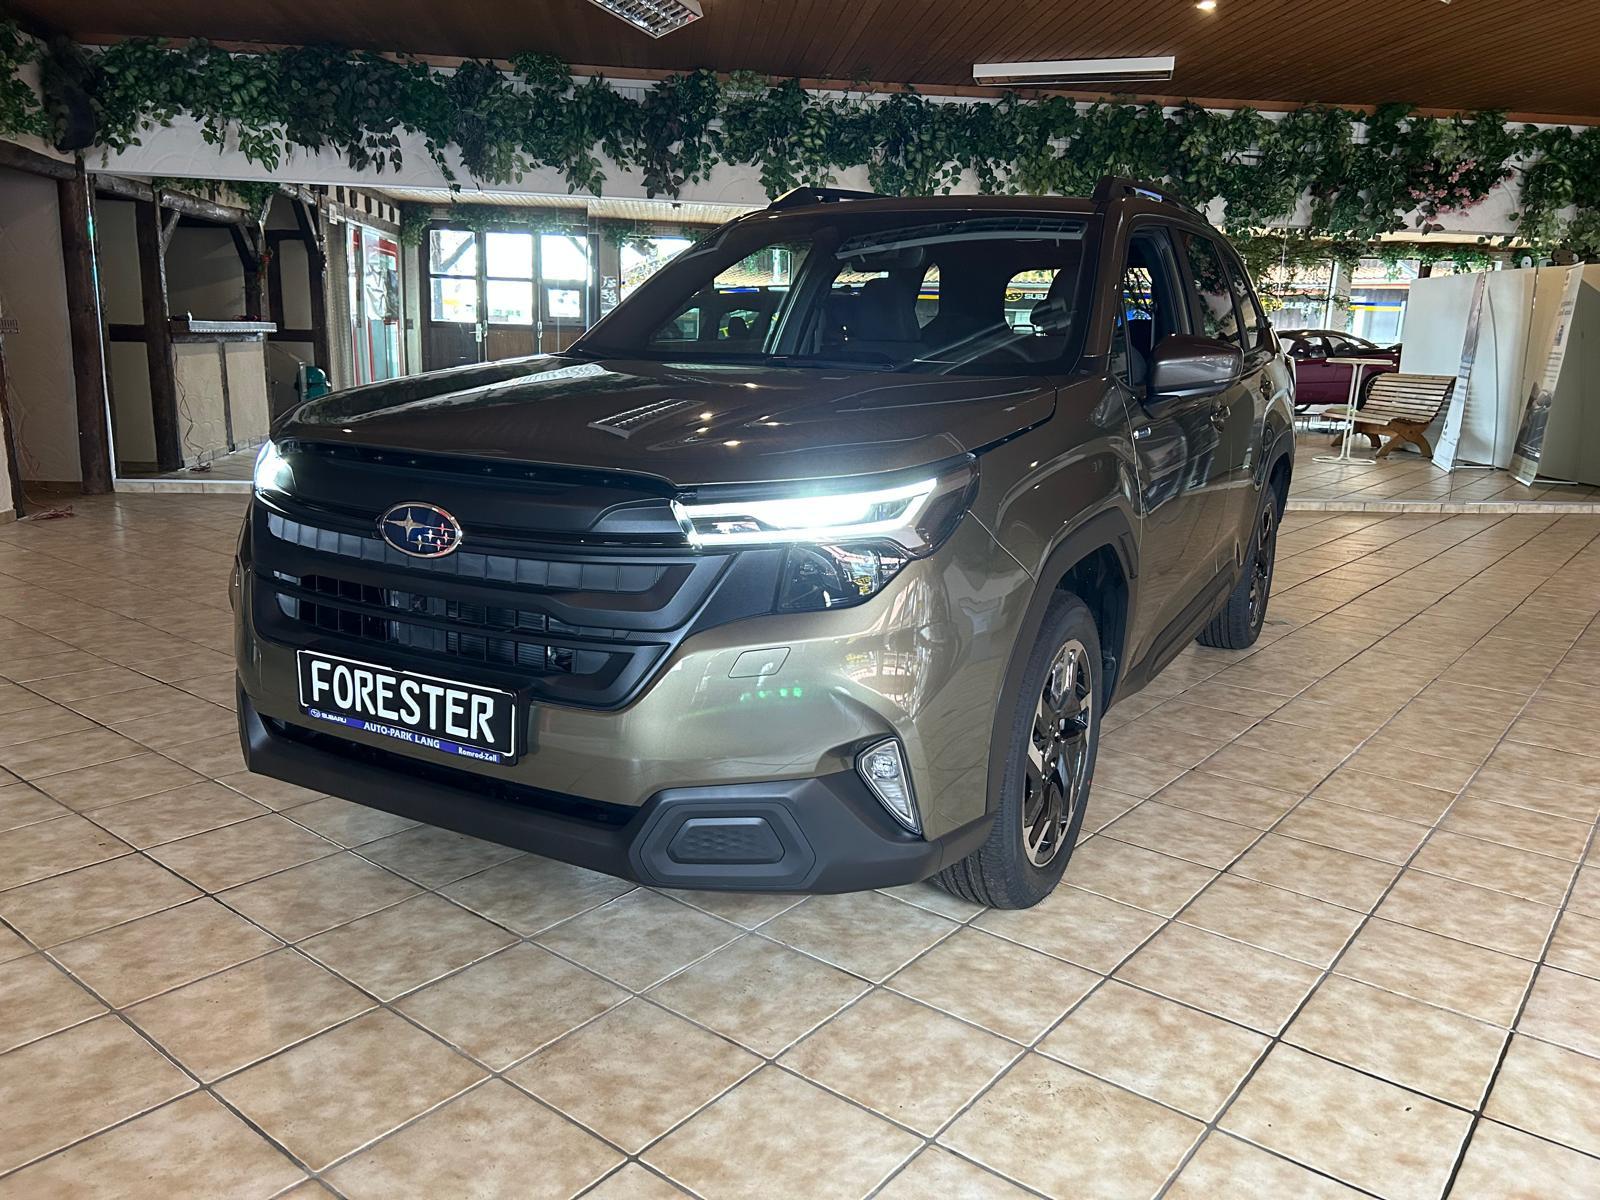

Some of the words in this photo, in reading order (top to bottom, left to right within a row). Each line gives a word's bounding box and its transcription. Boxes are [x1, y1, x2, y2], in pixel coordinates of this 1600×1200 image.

[311, 659, 495, 743] FORESTER
[321, 712, 347, 724] SUBARU
[363, 721, 413, 742] AUTO-PARK
[414, 734, 440, 749] LANG
